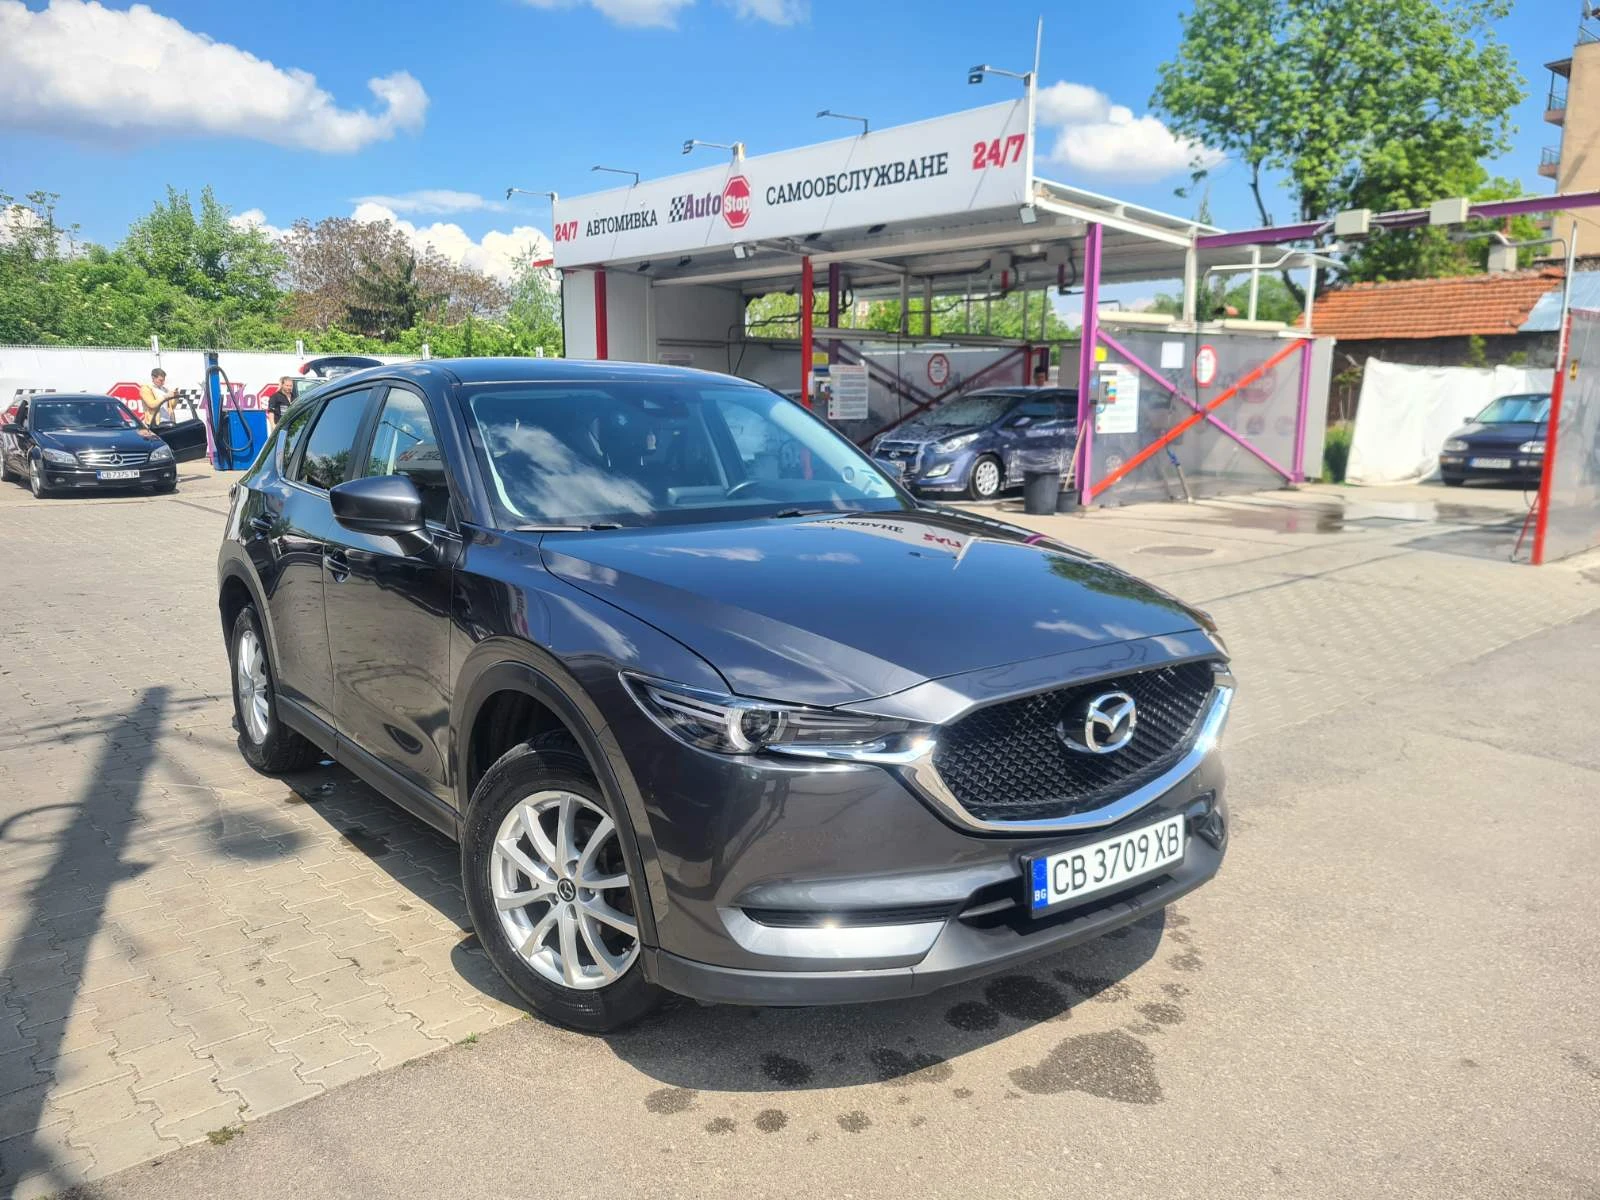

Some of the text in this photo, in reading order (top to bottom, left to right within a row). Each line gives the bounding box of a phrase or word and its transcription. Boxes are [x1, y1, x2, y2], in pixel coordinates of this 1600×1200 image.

[766, 134, 1025, 205] САМООБСЛУЖВАНЕ 24/7
[683, 192, 750, 221] Auto Stop
[555, 210, 658, 241] 24/7 АВТОМИВКА
[1053, 823, 1179, 895] CB 3709 XB
[1034, 888, 1047, 901] BG
